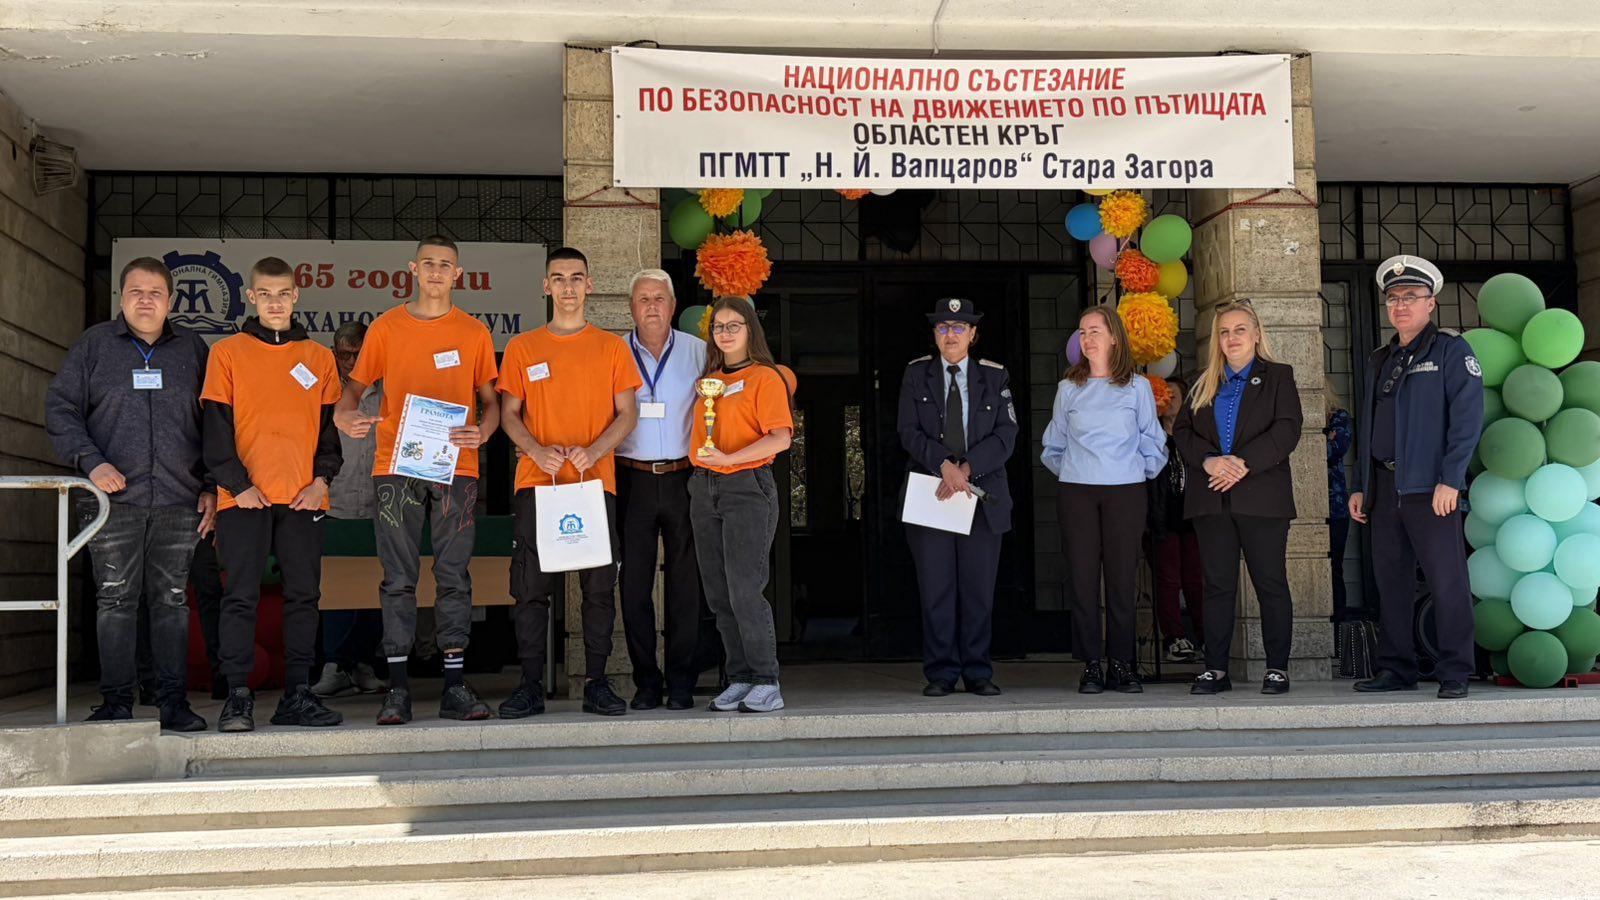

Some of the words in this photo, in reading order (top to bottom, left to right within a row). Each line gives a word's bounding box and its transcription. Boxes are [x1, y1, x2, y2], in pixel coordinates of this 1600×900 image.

[785, 65, 960, 94] НАЦИОНАЛНО
[968, 67, 1126, 92] СЪСТЕЗАНИЕ
[639, 87, 673, 113] ПО
[682, 87, 862, 117] БЕЗОПАСНОСТ
[870, 98, 905, 118] НА
[912, 98, 1085, 123] ДВИЖЕНИЕТО
[1092, 96, 1127, 117] ПО
[1134, 92, 1267, 121] ПЪТИЩАТА
[853, 122, 989, 146] ОБЛАСТЕН
[998, 123, 1065, 146] КРЪГ
[699, 151, 791, 178] ПГМТТ
[1042, 152, 1115, 184] Стара
[1125, 153, 1214, 184] Загора
[294, 263, 335, 289] 65
